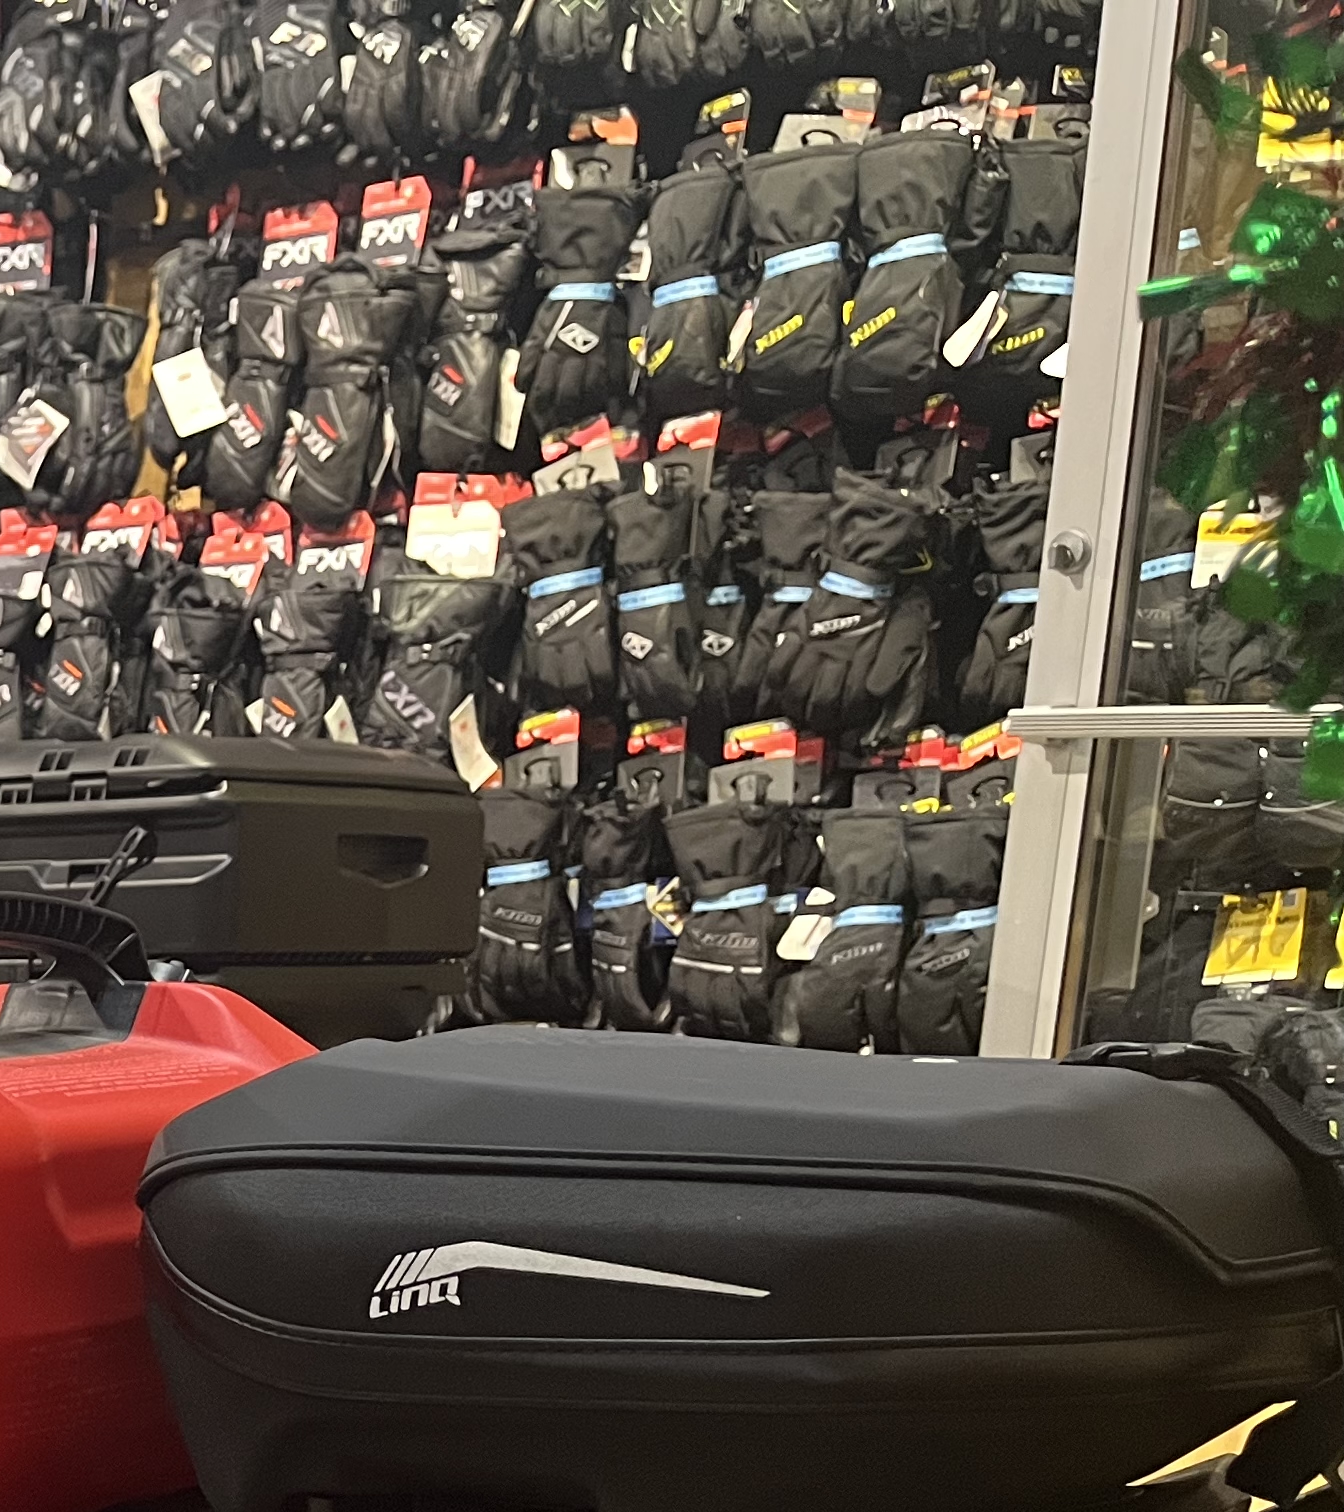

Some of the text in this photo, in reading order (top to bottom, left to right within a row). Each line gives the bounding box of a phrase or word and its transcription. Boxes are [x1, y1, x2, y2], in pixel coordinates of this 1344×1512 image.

[464, 181, 534, 219] FXR
[361, 213, 419, 249] FXR
[263, 234, 329, 271] FXR
[81, 526, 144, 554] FXR
[298, 542, 364, 575] FXR
